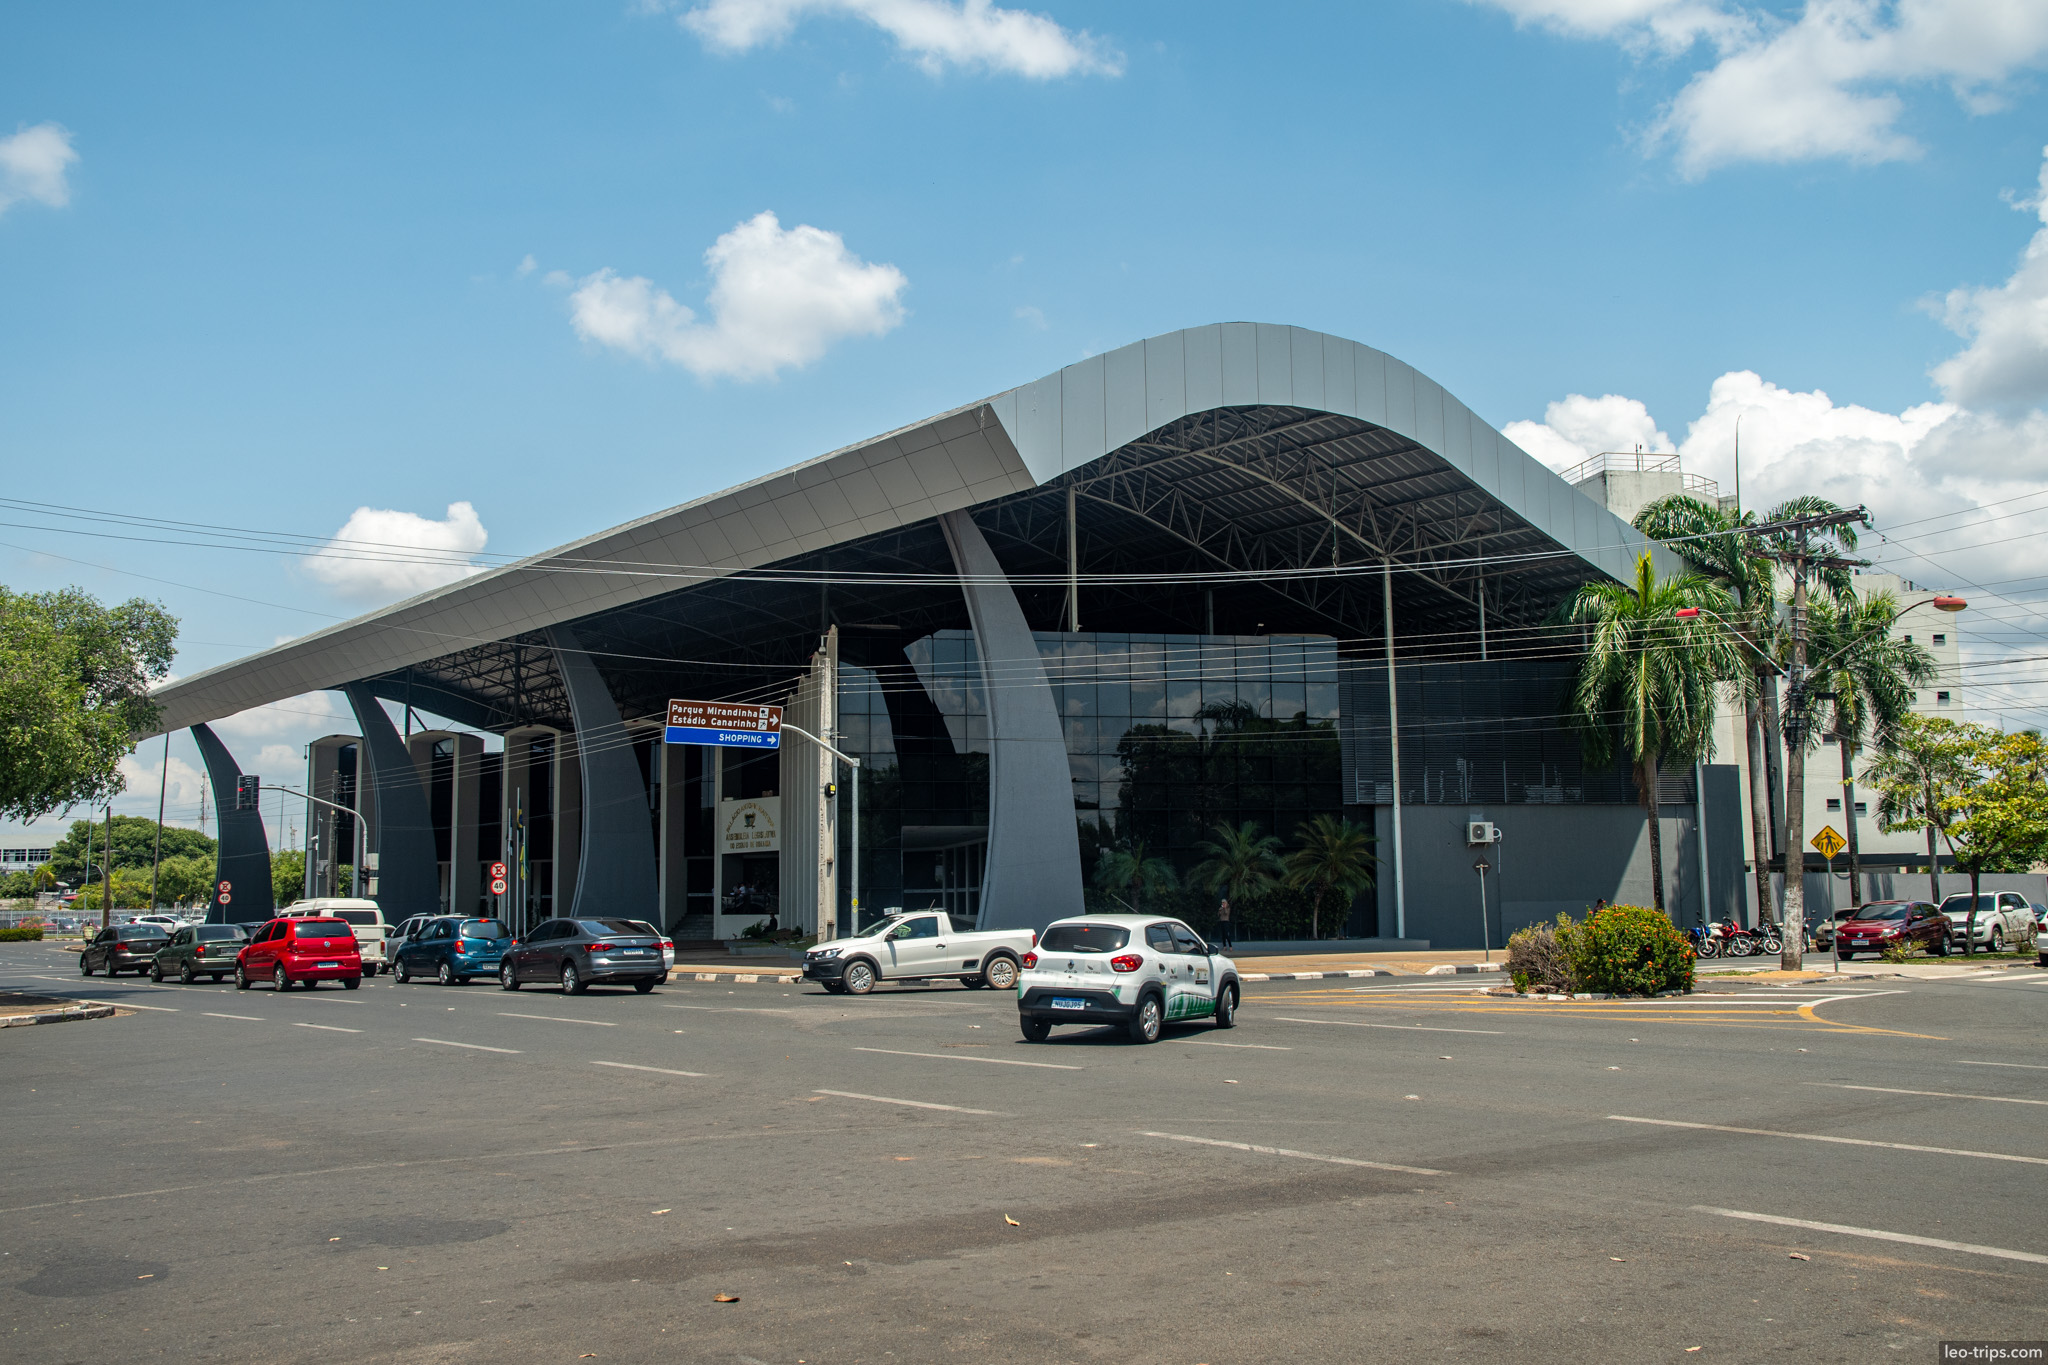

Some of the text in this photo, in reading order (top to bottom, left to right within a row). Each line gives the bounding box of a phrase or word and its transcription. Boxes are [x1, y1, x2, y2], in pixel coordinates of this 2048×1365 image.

[672, 704, 758, 718] Parque Mirandinha
[672, 714, 757, 728] Estádio Canarinho
[718, 733, 762, 743] SHOPPING
[493, 881, 504, 889] 40
